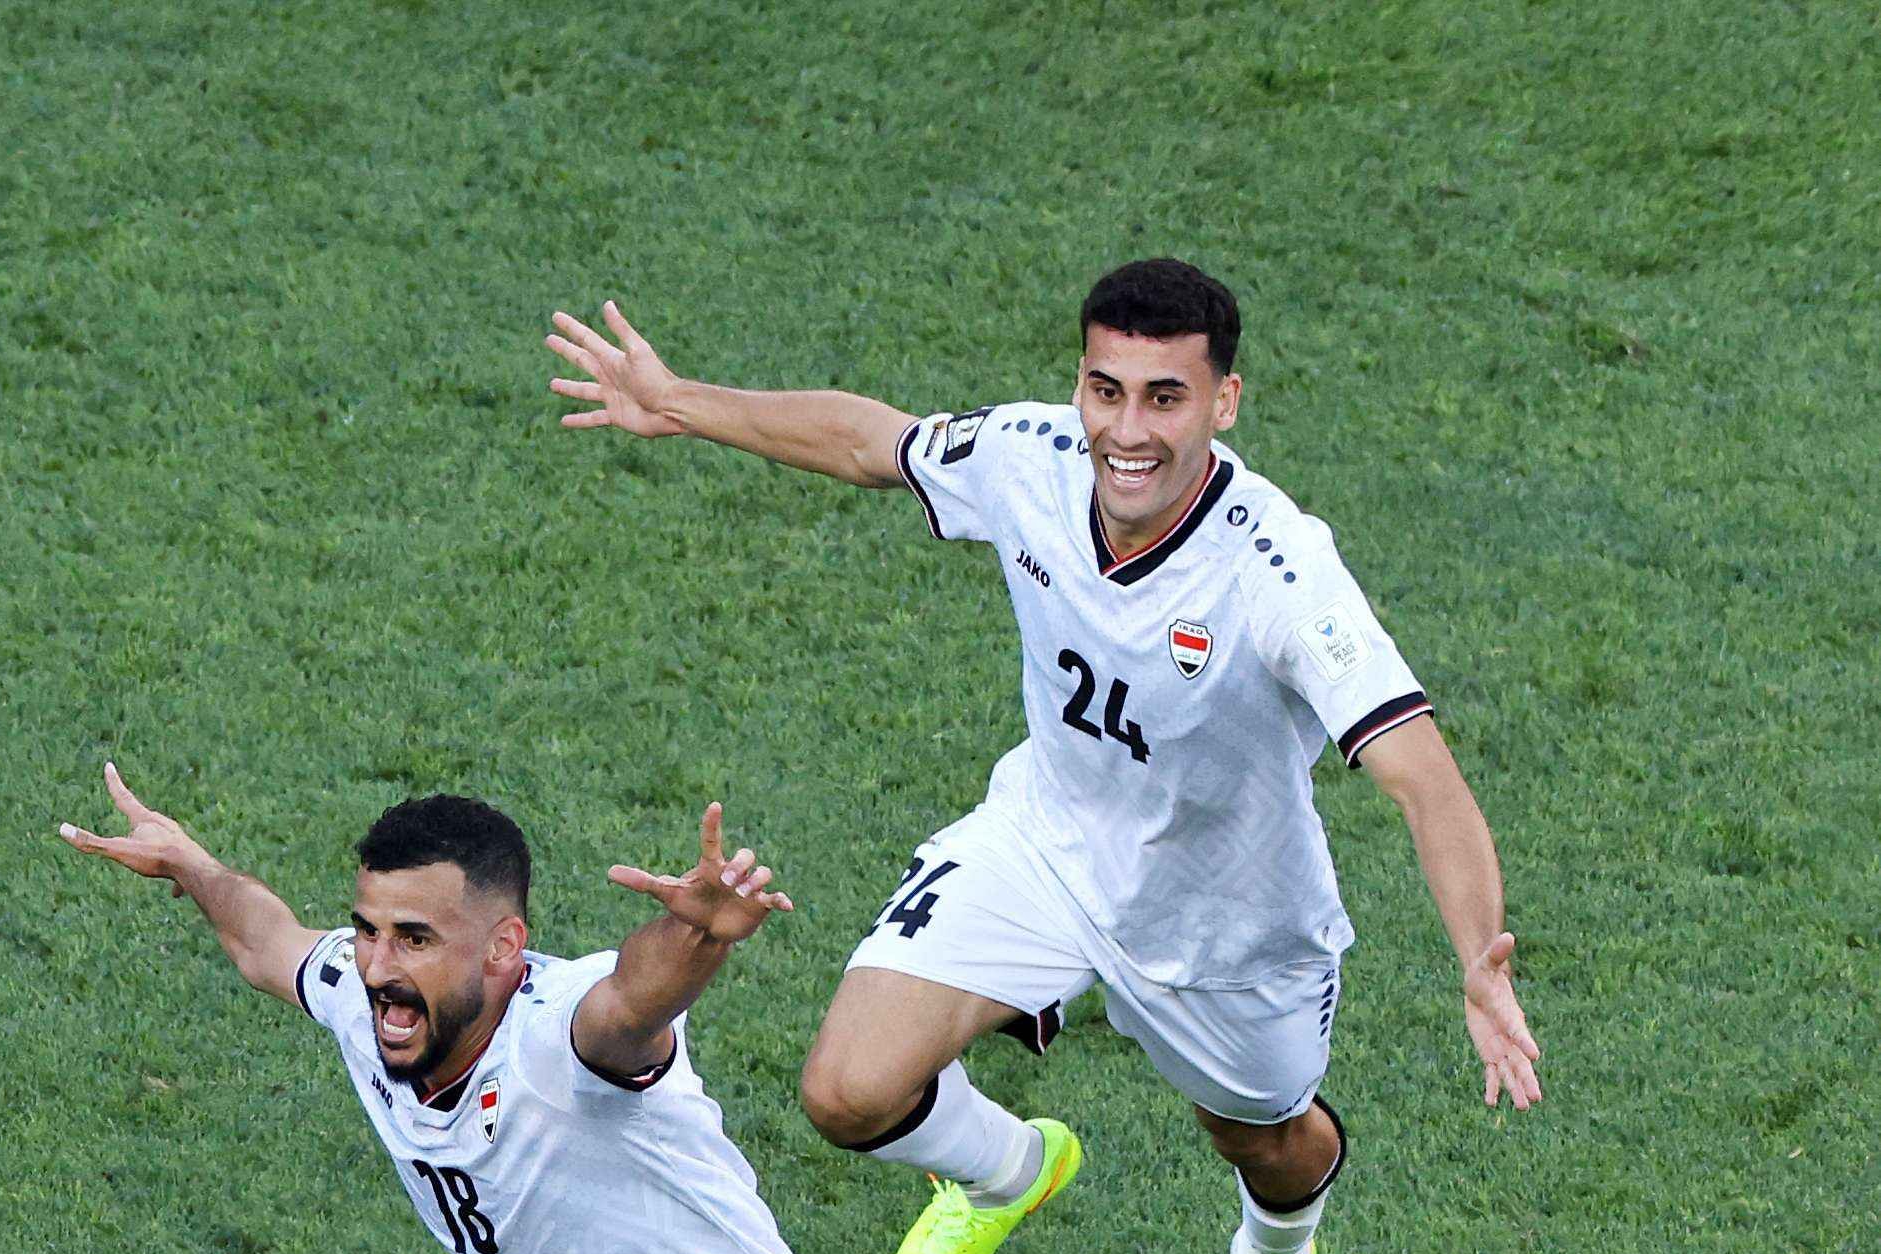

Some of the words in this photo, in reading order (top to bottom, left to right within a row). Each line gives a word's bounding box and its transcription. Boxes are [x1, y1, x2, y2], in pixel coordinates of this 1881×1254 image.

[1015, 549, 1051, 588] JAKO
[1057, 648, 1152, 765] 24
[371, 1071, 393, 1110] JAKO
